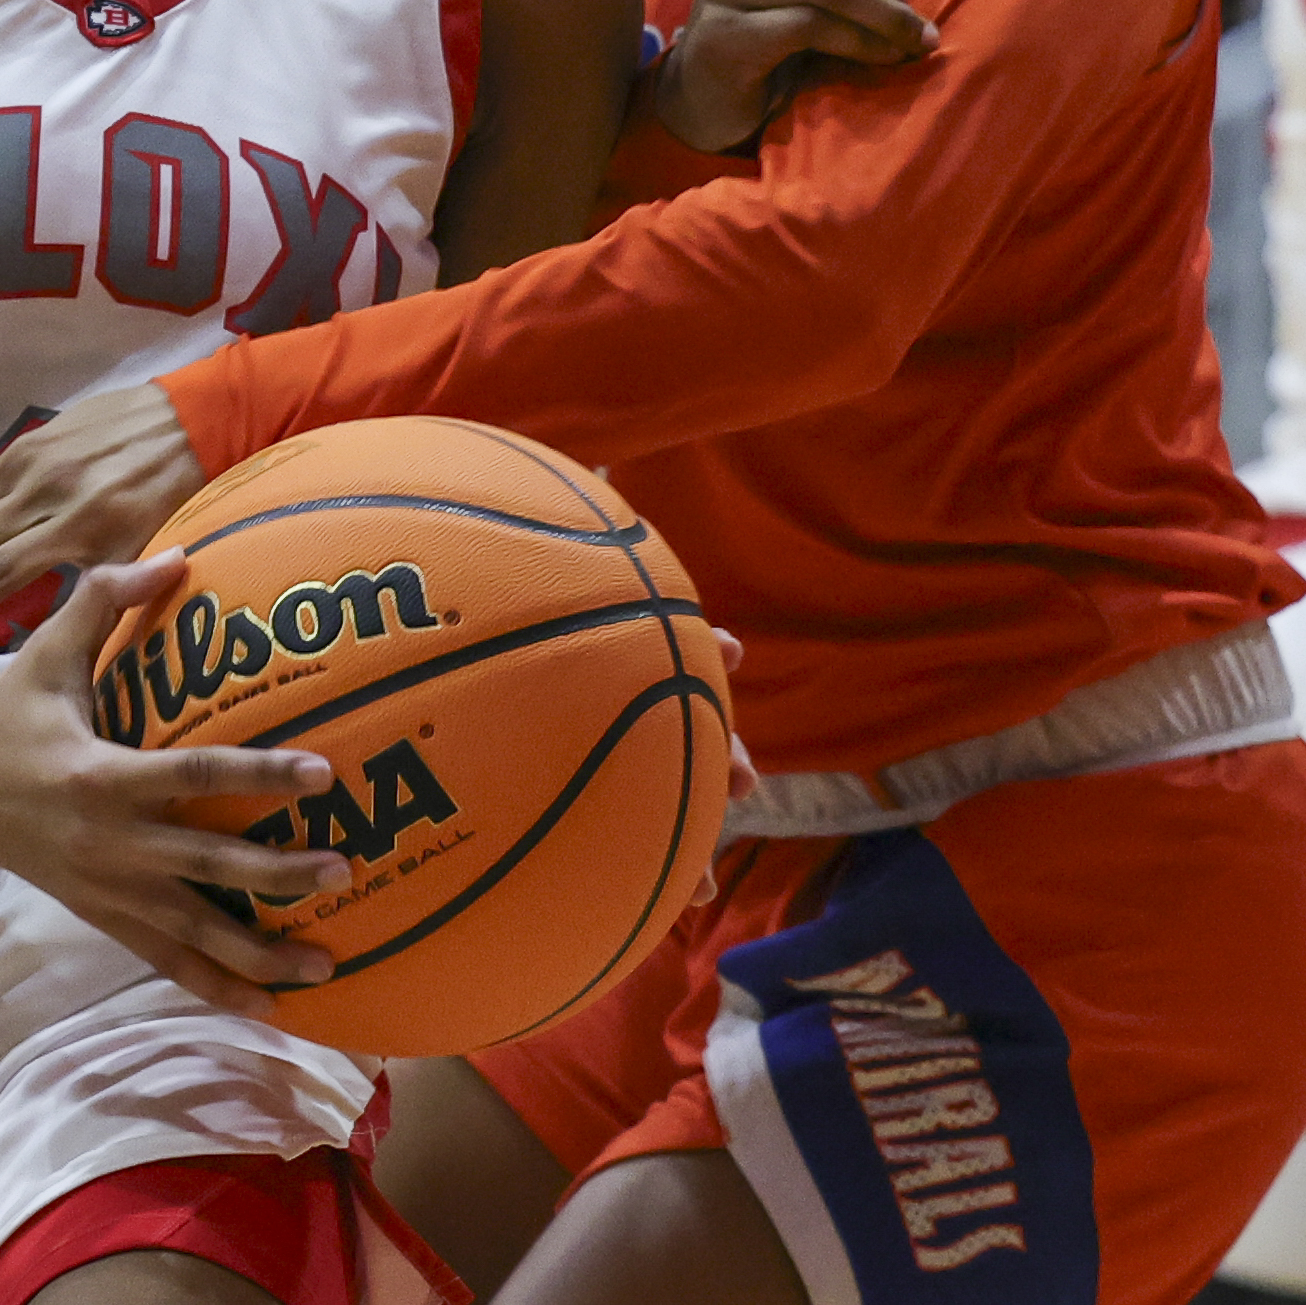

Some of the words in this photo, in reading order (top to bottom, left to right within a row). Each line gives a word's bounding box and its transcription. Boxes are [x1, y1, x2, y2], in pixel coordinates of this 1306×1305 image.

[94, 561, 442, 749] Wilson
[277, 662, 330, 686] BALL
[179, 737, 462, 926] AA
[314, 870, 395, 919] GAME
[398, 829, 476, 875] BALL
